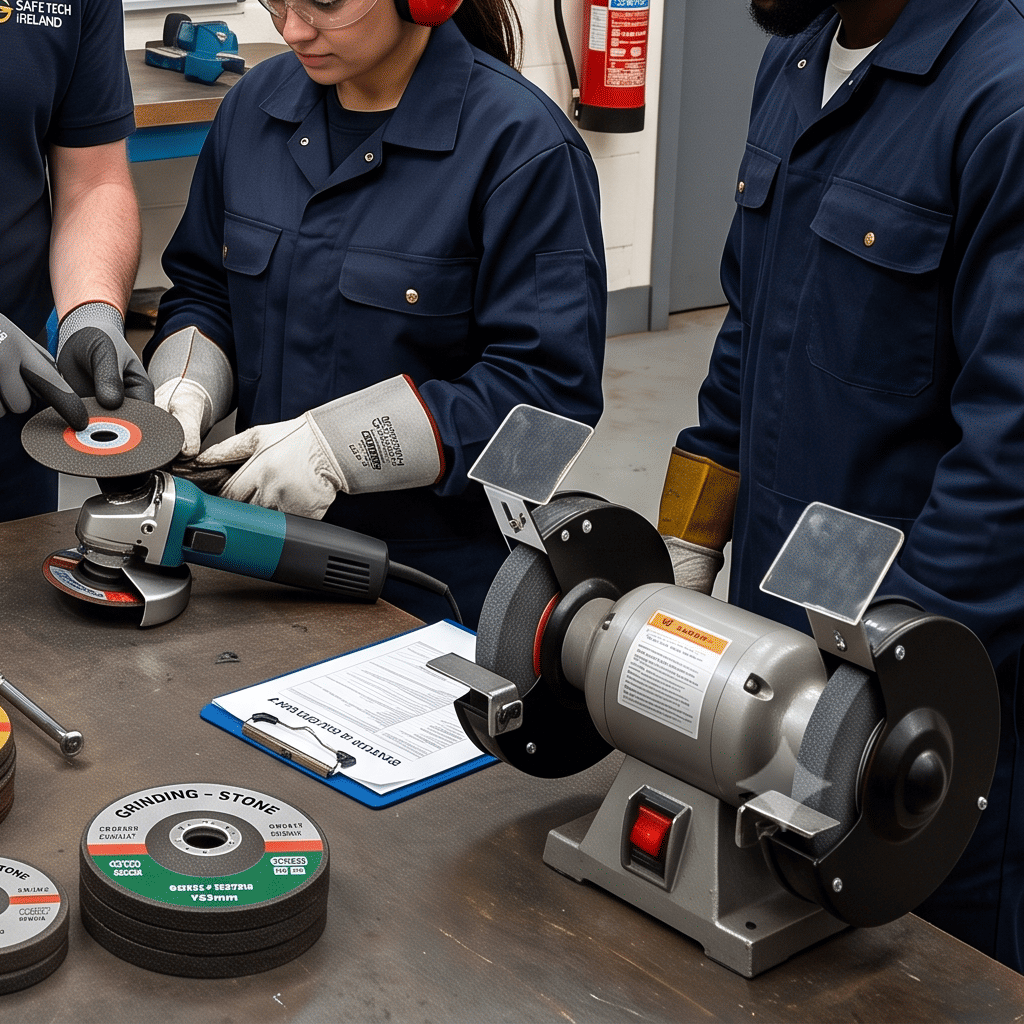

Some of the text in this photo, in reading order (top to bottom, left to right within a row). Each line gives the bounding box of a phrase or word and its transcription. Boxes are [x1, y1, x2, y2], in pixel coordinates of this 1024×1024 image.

[16, 0, 72, 16] SAFE TECH
[115, 789, 199, 819] GRINDING
[218, 790, 280, 816] STONE
